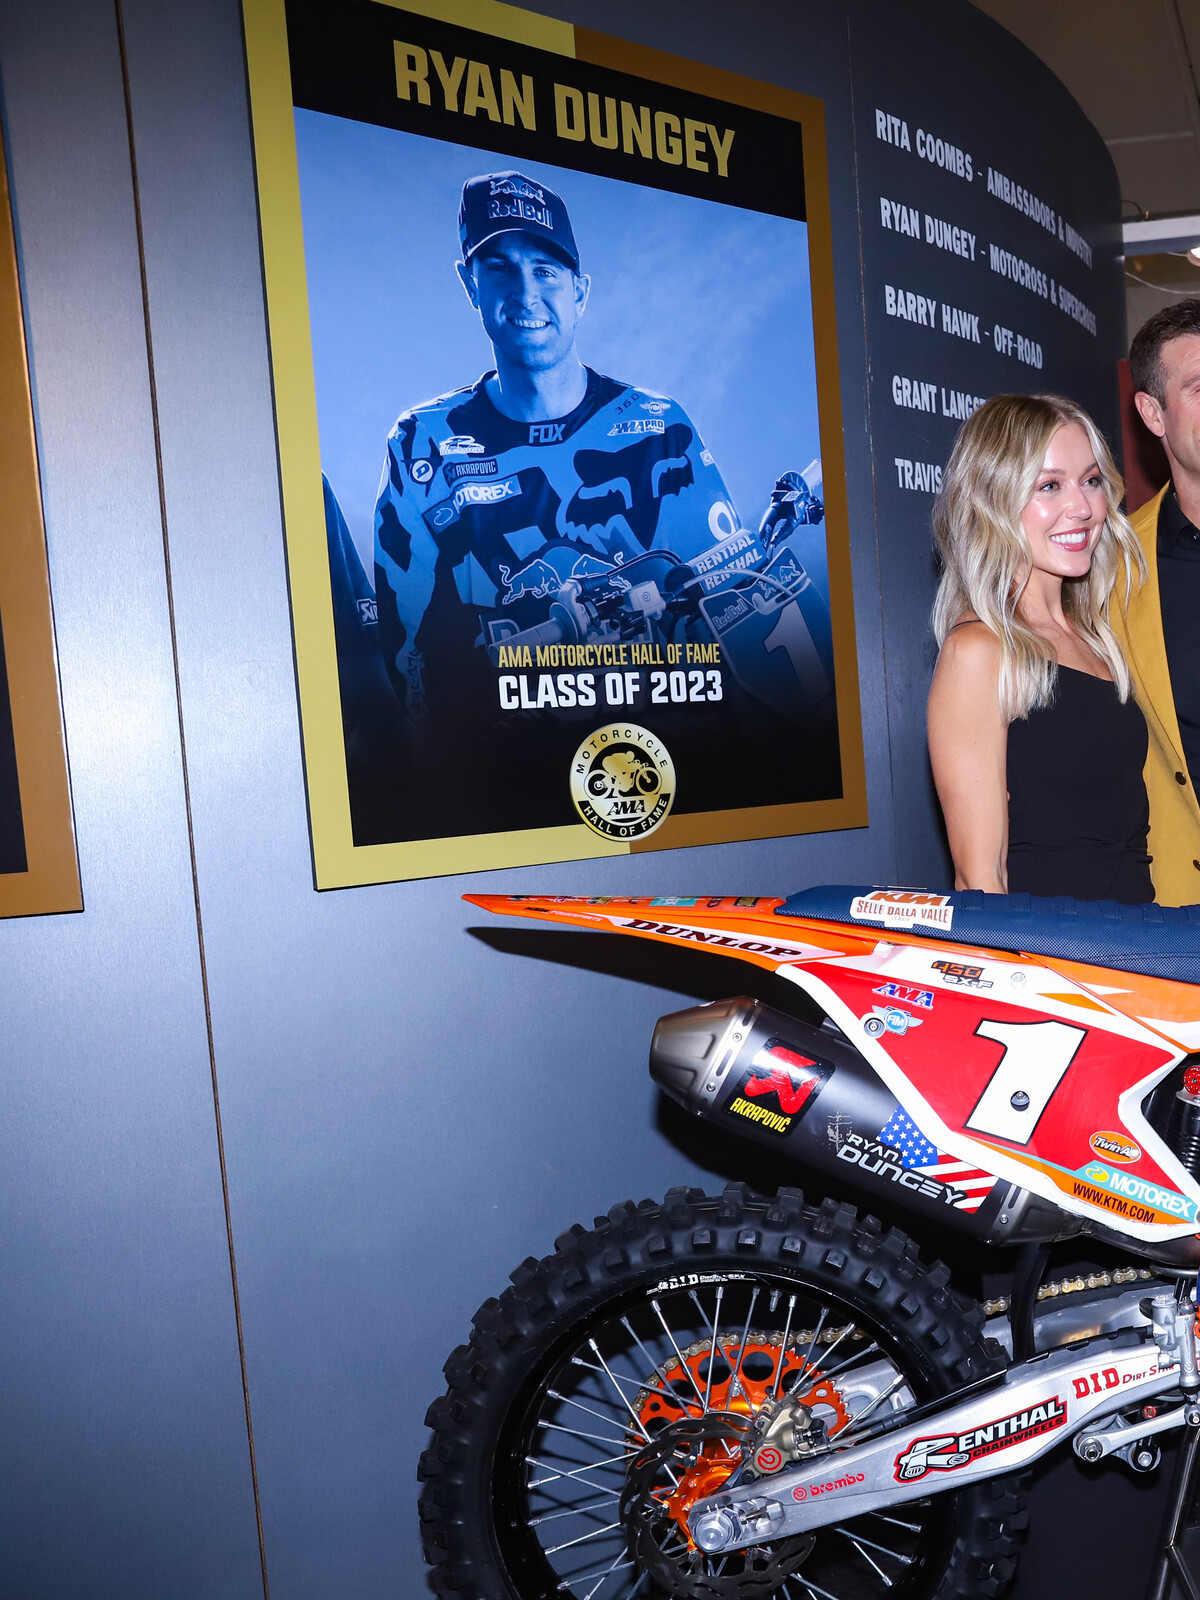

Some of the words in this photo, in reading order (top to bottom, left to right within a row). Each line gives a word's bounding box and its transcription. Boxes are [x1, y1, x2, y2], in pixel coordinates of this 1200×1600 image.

[393, 40, 536, 131] RYAN
[554, 83, 735, 177] DUNGEY
[875, 108, 911, 152] RITA
[916, 128, 974, 183] COOMBS
[987, 166, 1056, 236] AMBASSADORS
[880, 196, 921, 240] RYAN
[924, 214, 976, 262] DUNGEY
[989, 243, 1048, 300] MOTOCROSS
[884, 284, 937, 329] BARRY
[941, 303, 981, 344] HAWK
[993, 324, 1044, 370] OFF-ROAD
[892, 375, 937, 414] GRANT
[529, 424, 566, 444] FOX
[895, 457, 942, 494] TRAVIS
[696, 534, 755, 573] RENTHAL
[705, 548, 763, 591] RENTHAL
[498, 646, 533, 668] AMA
[536, 645, 628, 667] MOTORCYCLE
[631, 645, 664, 665] HALL
[667, 644, 683, 664] OF
[686, 643, 720, 664] FAME
[498, 673, 597, 710] CLASS
[604, 671, 640, 706] OF
[650, 669, 724, 704] 2023
[576, 729, 668, 774] MOTORCYCLE
[583, 806, 612, 834] HALL
[619, 827, 636, 837] OF
[641, 799, 668, 831] FAME
[606, 800, 646, 816] AMA
[856, 900, 884, 915] SELLE
[887, 907, 917, 918] DALLA
[921, 909, 949, 924] VALLE
[870, 892, 951, 906] KTM
[621, 919, 802, 956] DUNLOP
[931, 961, 982, 978] 450
[943, 974, 994, 989] SX-F
[872, 982, 935, 1011] AMA
[887, 1014, 906, 1027] FIM
[962, 1018, 1089, 1147] 1
[848, 1133, 900, 1165] RYAN
[837, 1144, 964, 1205] DUNGEY
[1073, 1182, 1155, 1223] WWW.KTM.COM
[1109, 1172, 1193, 1217] MOTOREX
[1072, 1367, 1120, 1399] D.I.D
[973, 1417, 1063, 1457] CHAINWHEELS
[809, 1471, 865, 1496] brembo
